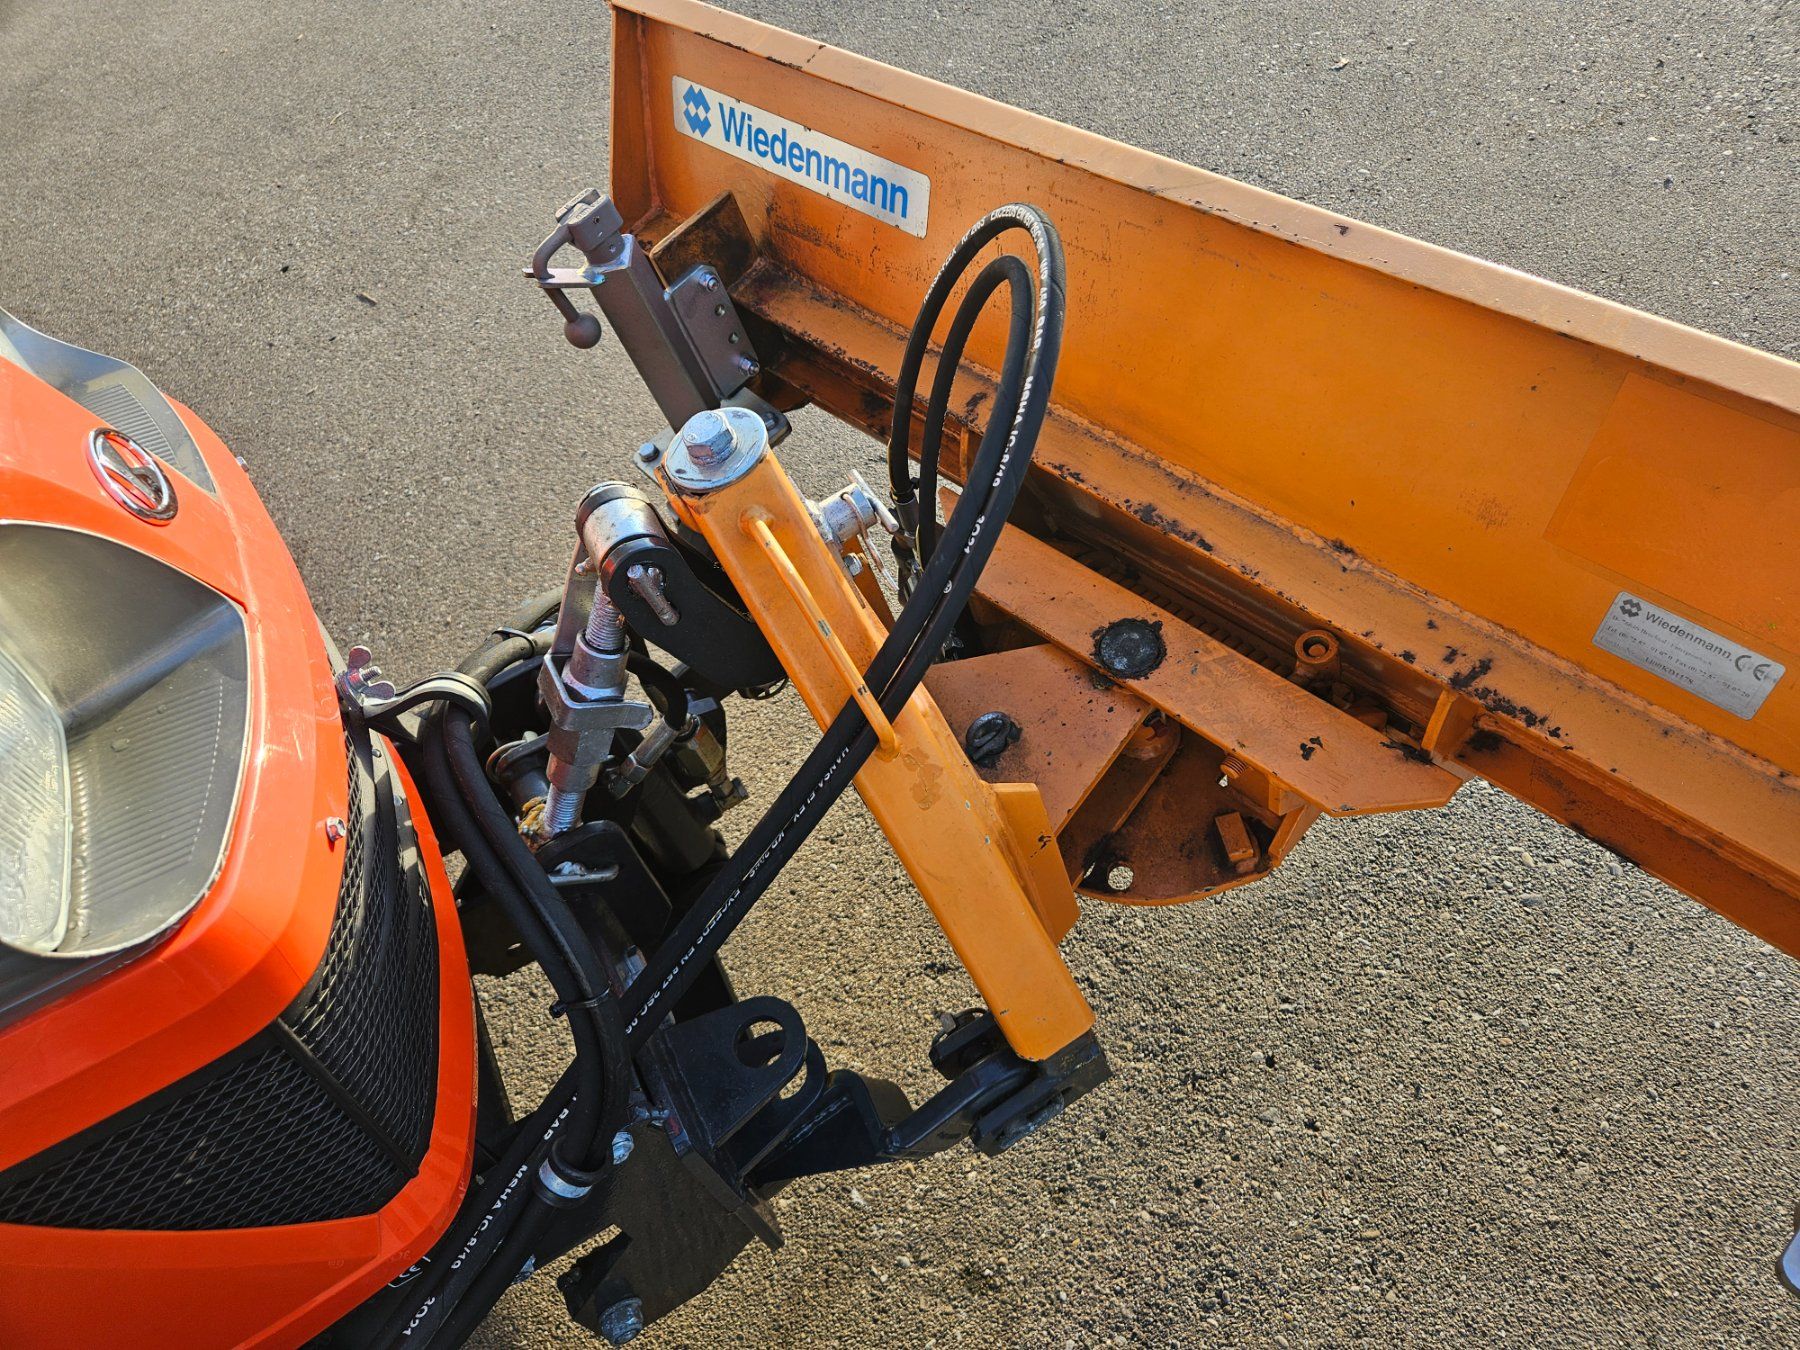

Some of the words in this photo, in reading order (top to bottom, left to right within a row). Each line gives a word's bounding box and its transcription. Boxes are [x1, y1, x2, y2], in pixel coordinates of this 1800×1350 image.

[718, 102, 909, 219] Wiedenmann
[1033, 315, 1046, 349] BAR
[1013, 375, 1034, 425] MSHA
[1735, 655, 1771, 681] CE
[696, 888, 742, 945] EXCEEDS
[680, 945, 696, 966] EN
[543, 1108, 570, 1141] BAR
[491, 1164, 528, 1210] MSHA
